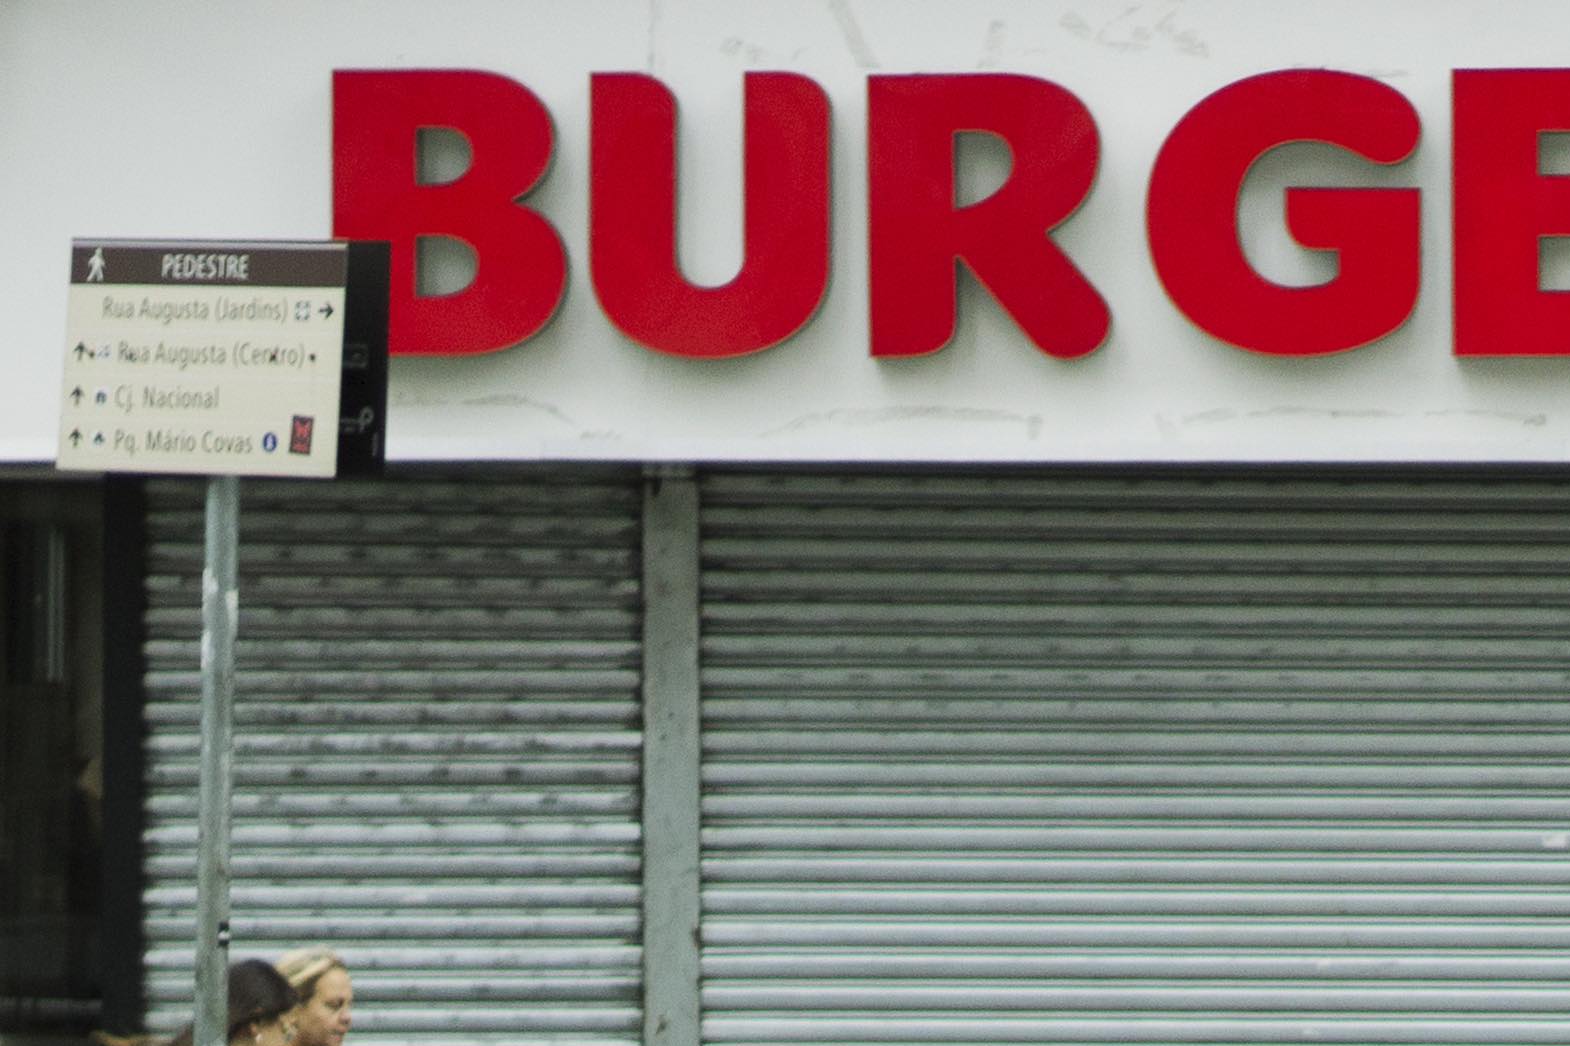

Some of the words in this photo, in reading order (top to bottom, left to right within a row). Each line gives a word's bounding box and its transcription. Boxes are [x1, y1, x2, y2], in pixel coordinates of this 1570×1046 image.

[161, 254, 250, 280] PEDESTRE
[102, 297, 133, 318] Rua
[140, 297, 209, 323] Augusta
[214, 300, 288, 322] (Jardins)
[117, 342, 149, 362] Rua
[156, 344, 227, 369] Augusta
[233, 345, 306, 369] (Centro)
[143, 387, 219, 408] Nacional
[146, 431, 196, 452] Mário
[201, 433, 252, 453] Covas
